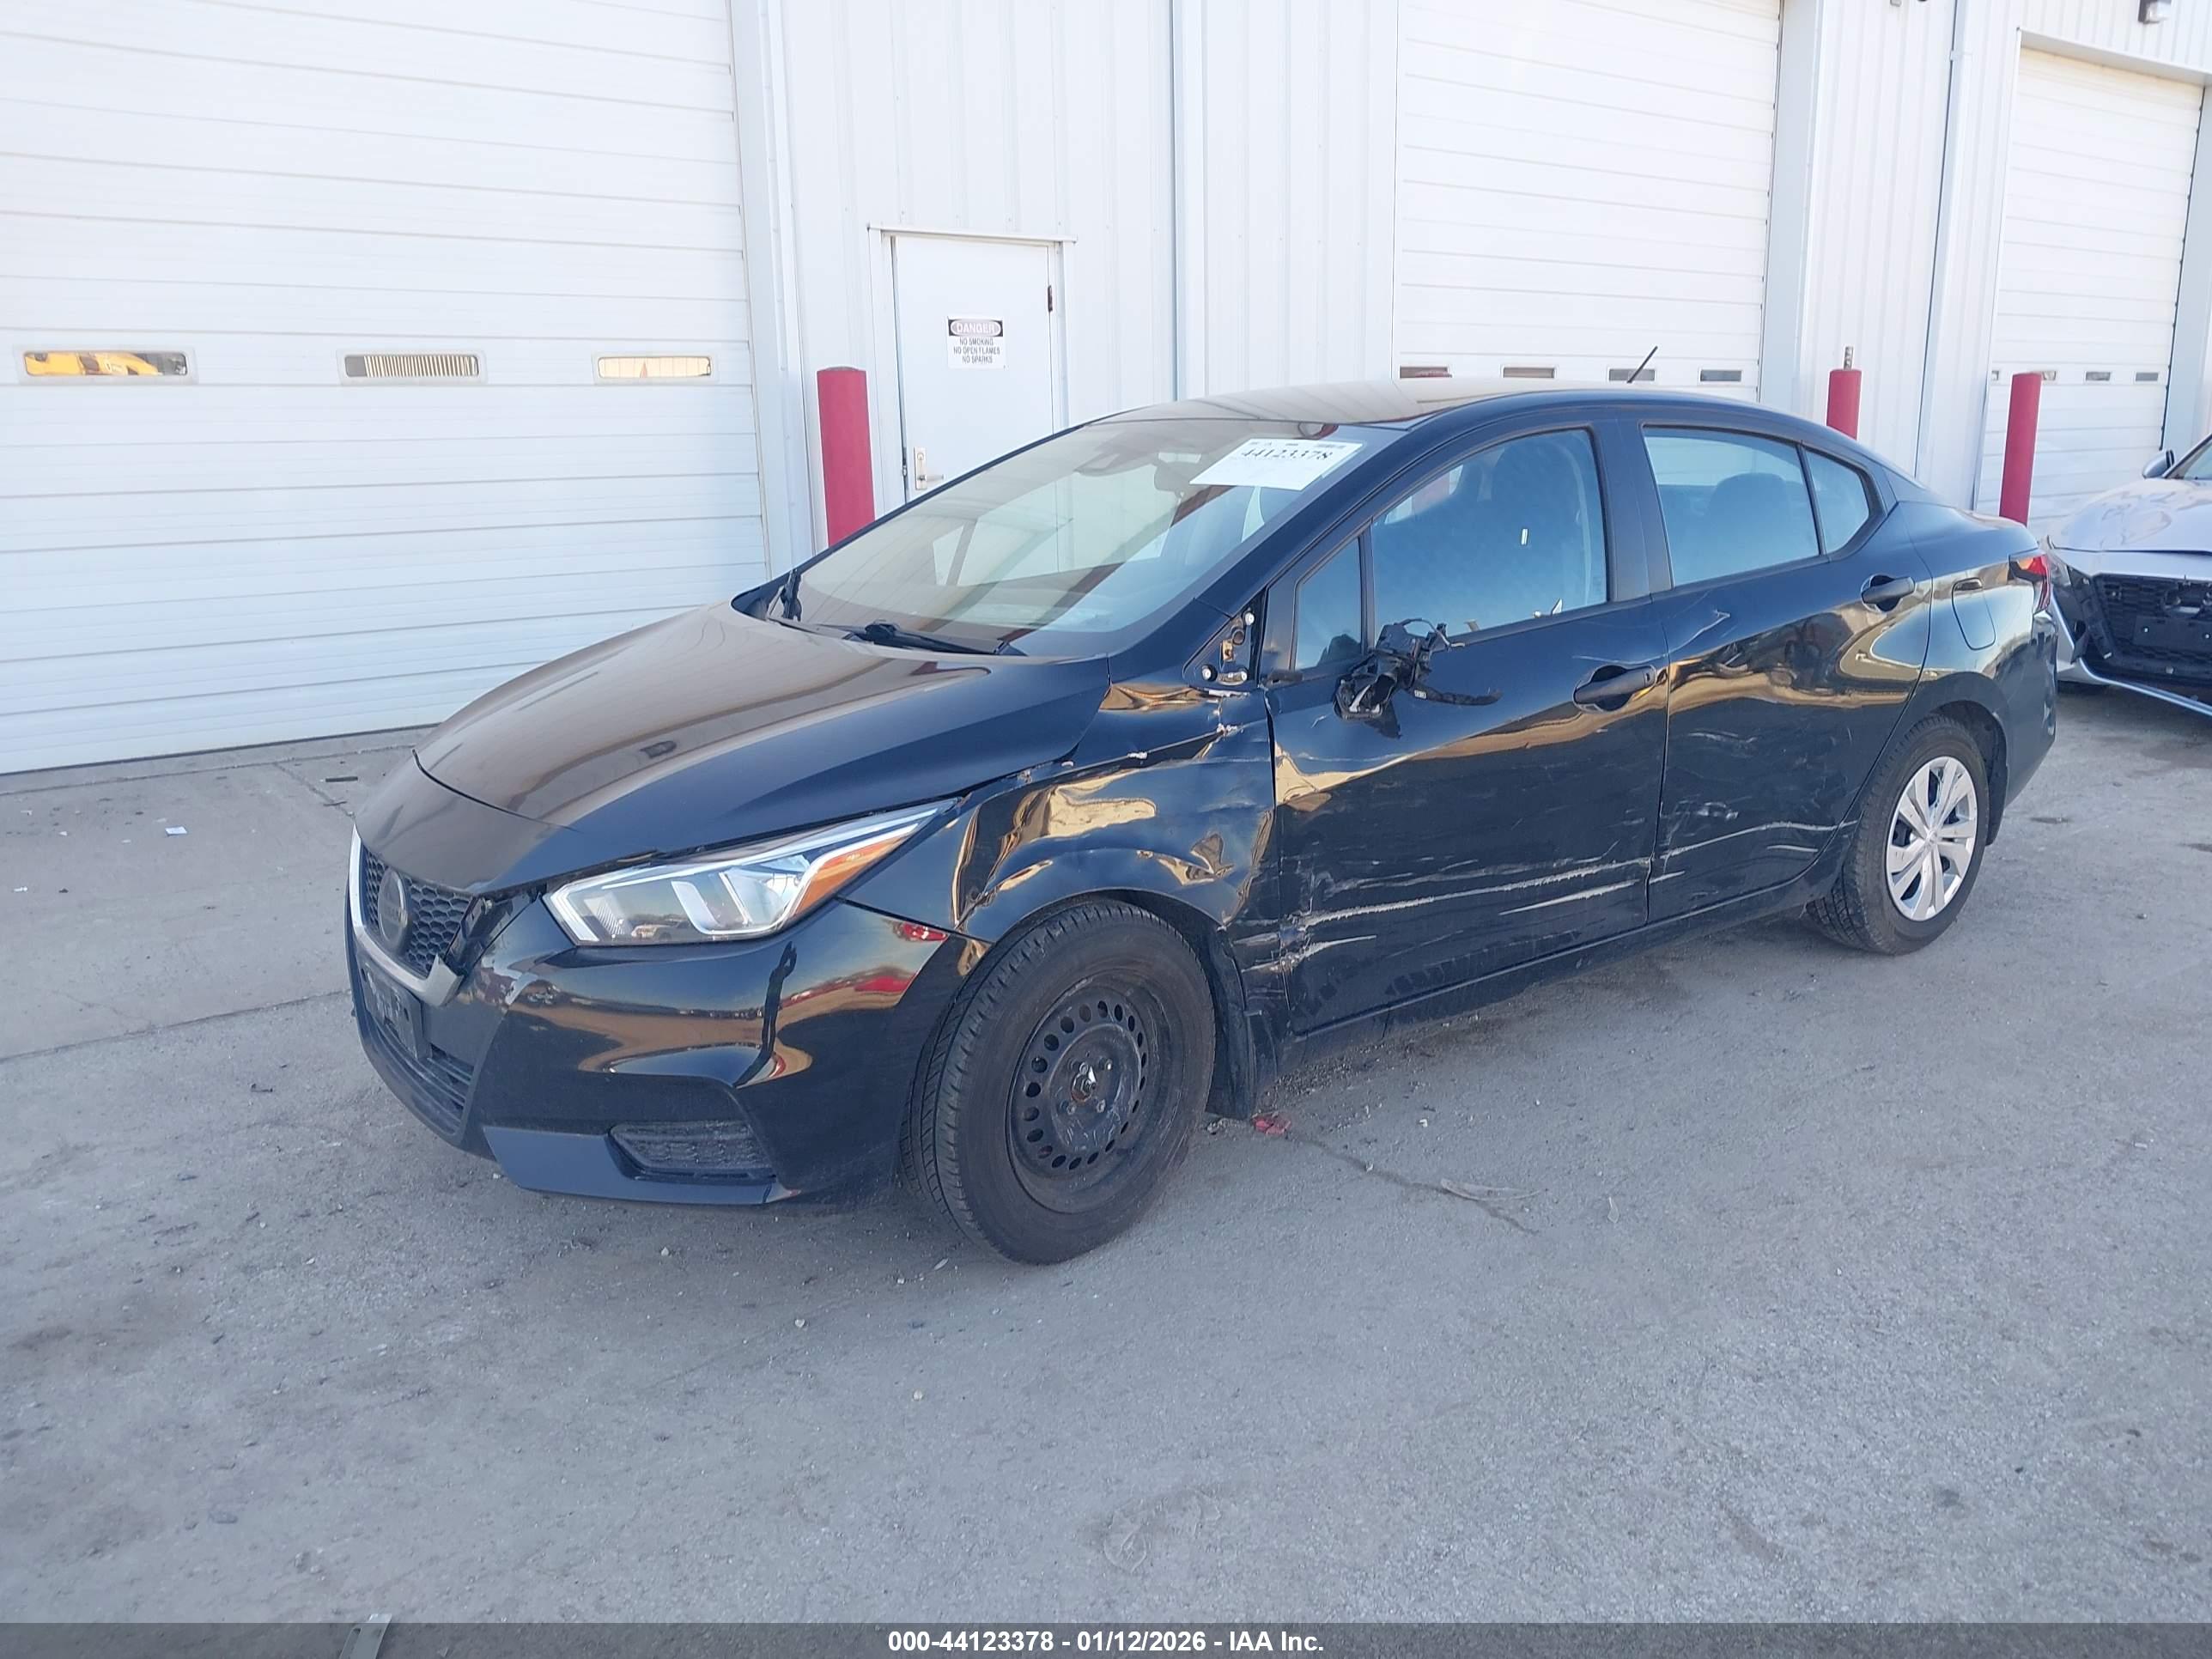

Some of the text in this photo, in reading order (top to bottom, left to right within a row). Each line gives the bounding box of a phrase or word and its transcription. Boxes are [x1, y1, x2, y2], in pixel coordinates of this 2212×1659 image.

[956, 322, 995, 334] DANGER
[959, 337, 994, 346] NO SMOKING
[953, 346, 1000, 355] NO OPEN FLAMES
[962, 356, 993, 364] NO SPARKS
